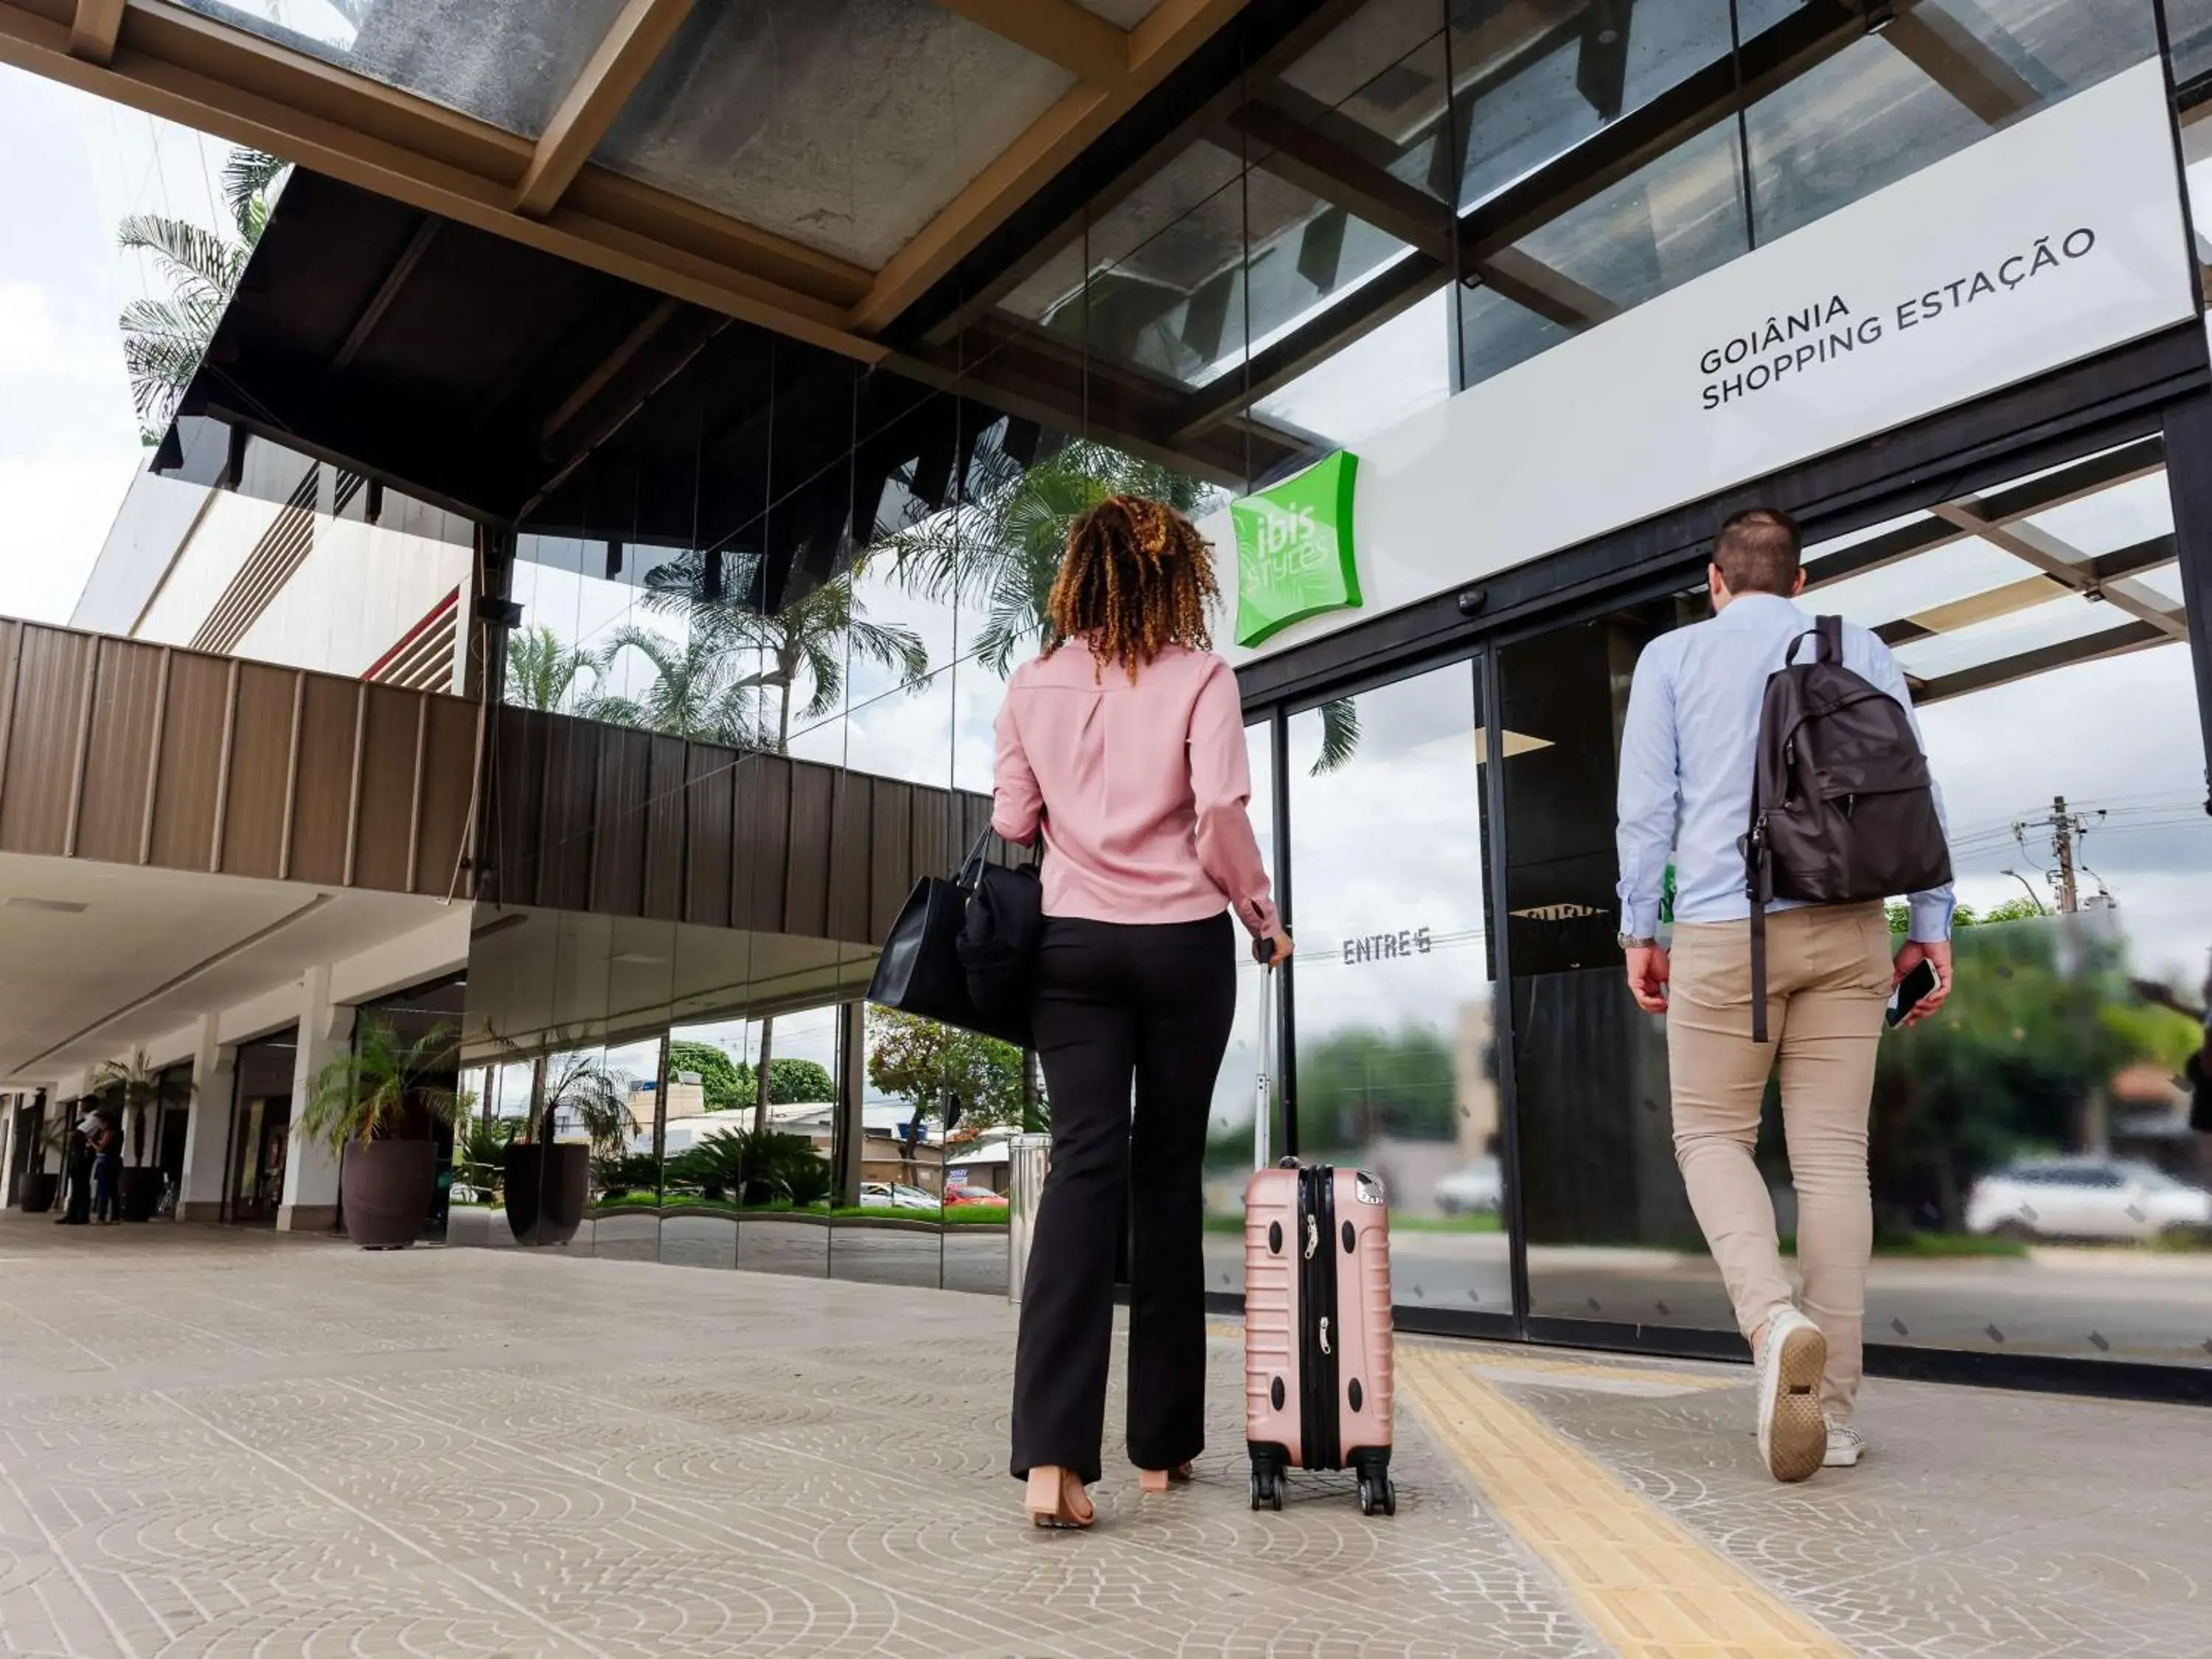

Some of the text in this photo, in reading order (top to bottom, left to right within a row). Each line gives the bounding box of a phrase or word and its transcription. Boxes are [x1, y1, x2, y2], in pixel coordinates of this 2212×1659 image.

[1700, 294, 1850, 375] GOIÂNIA
[1702, 227, 2096, 410] SHOPPING ESTAÇÃO
[1257, 501, 1315, 560] ibis
[1343, 930, 1411, 965] ENTRE
